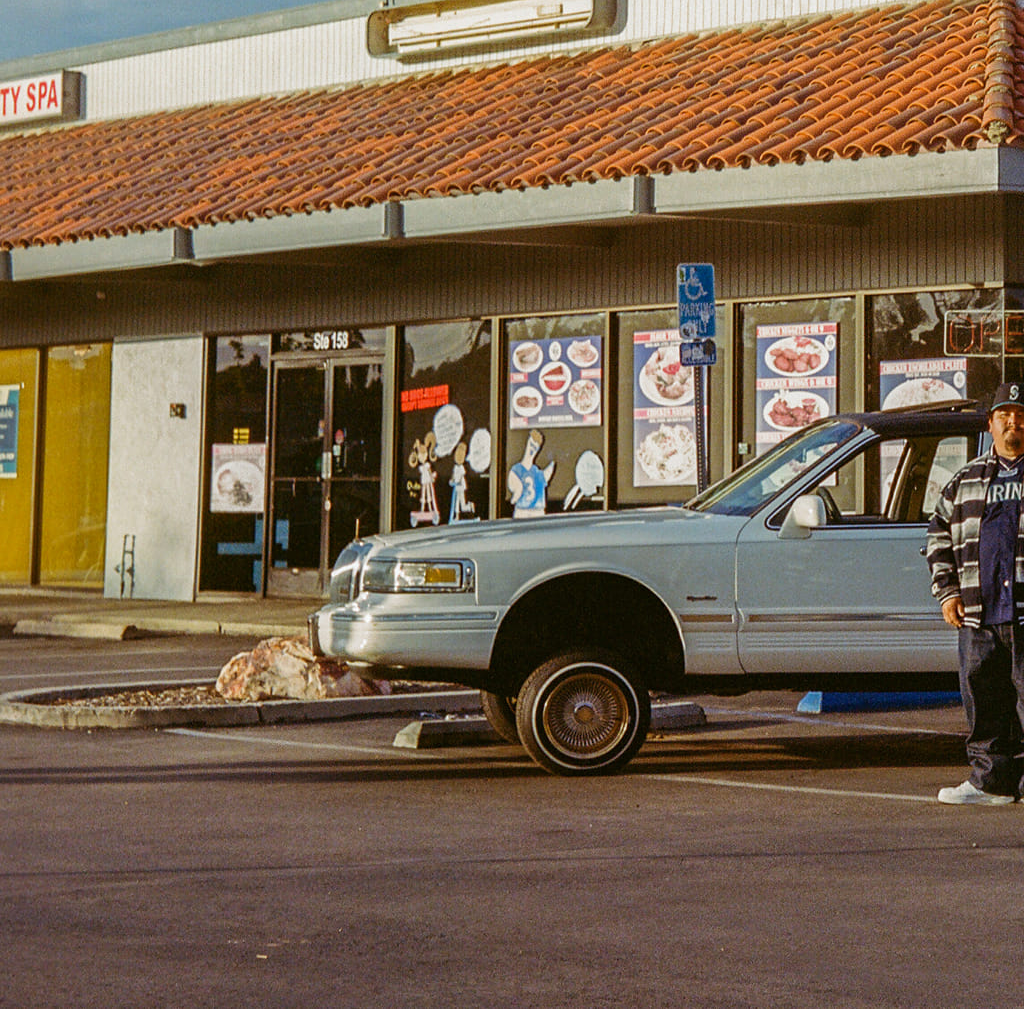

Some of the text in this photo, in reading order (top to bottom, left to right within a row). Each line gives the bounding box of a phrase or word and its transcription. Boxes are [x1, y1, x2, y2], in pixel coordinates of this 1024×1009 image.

[26, 79, 58, 112] SPA
[680, 302, 714, 318] PARKING
[313, 331, 349, 350] Ste 158
[1009, 385, 1019, 401] S
[523, 476, 536, 503] 3
[986, 482, 1022, 504] RIN
